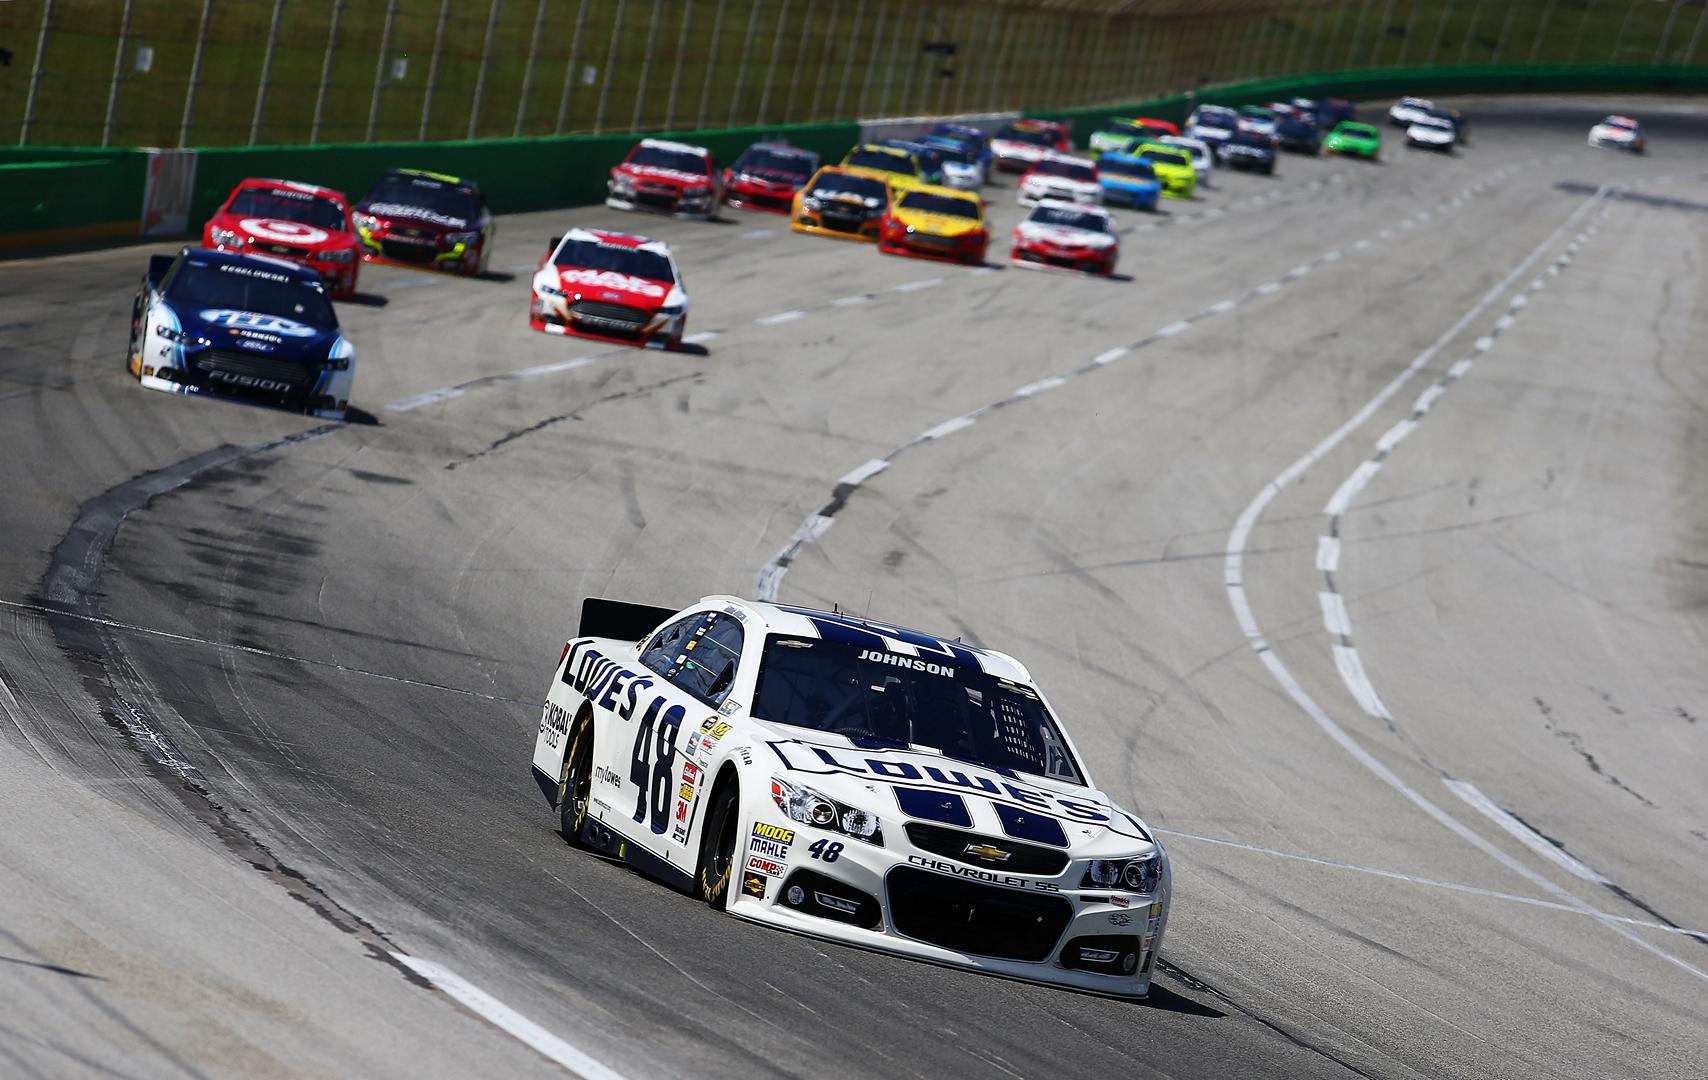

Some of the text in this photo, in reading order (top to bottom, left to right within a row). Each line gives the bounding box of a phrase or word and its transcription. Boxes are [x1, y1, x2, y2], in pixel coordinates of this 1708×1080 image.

[208, 370, 291, 393] FUSION
[857, 649, 954, 678] JOHNSON
[561, 639, 654, 722] LOWE'S
[630, 695, 686, 835] 48
[800, 746, 1111, 822] LOWE'S
[676, 800, 688, 824] 3M
[753, 822, 795, 843] MOOG
[749, 837, 788, 859] MAHLE
[807, 838, 845, 863] 48
[749, 858, 777, 872] COMP
[908, 855, 1059, 893] CHEVROLET SS
